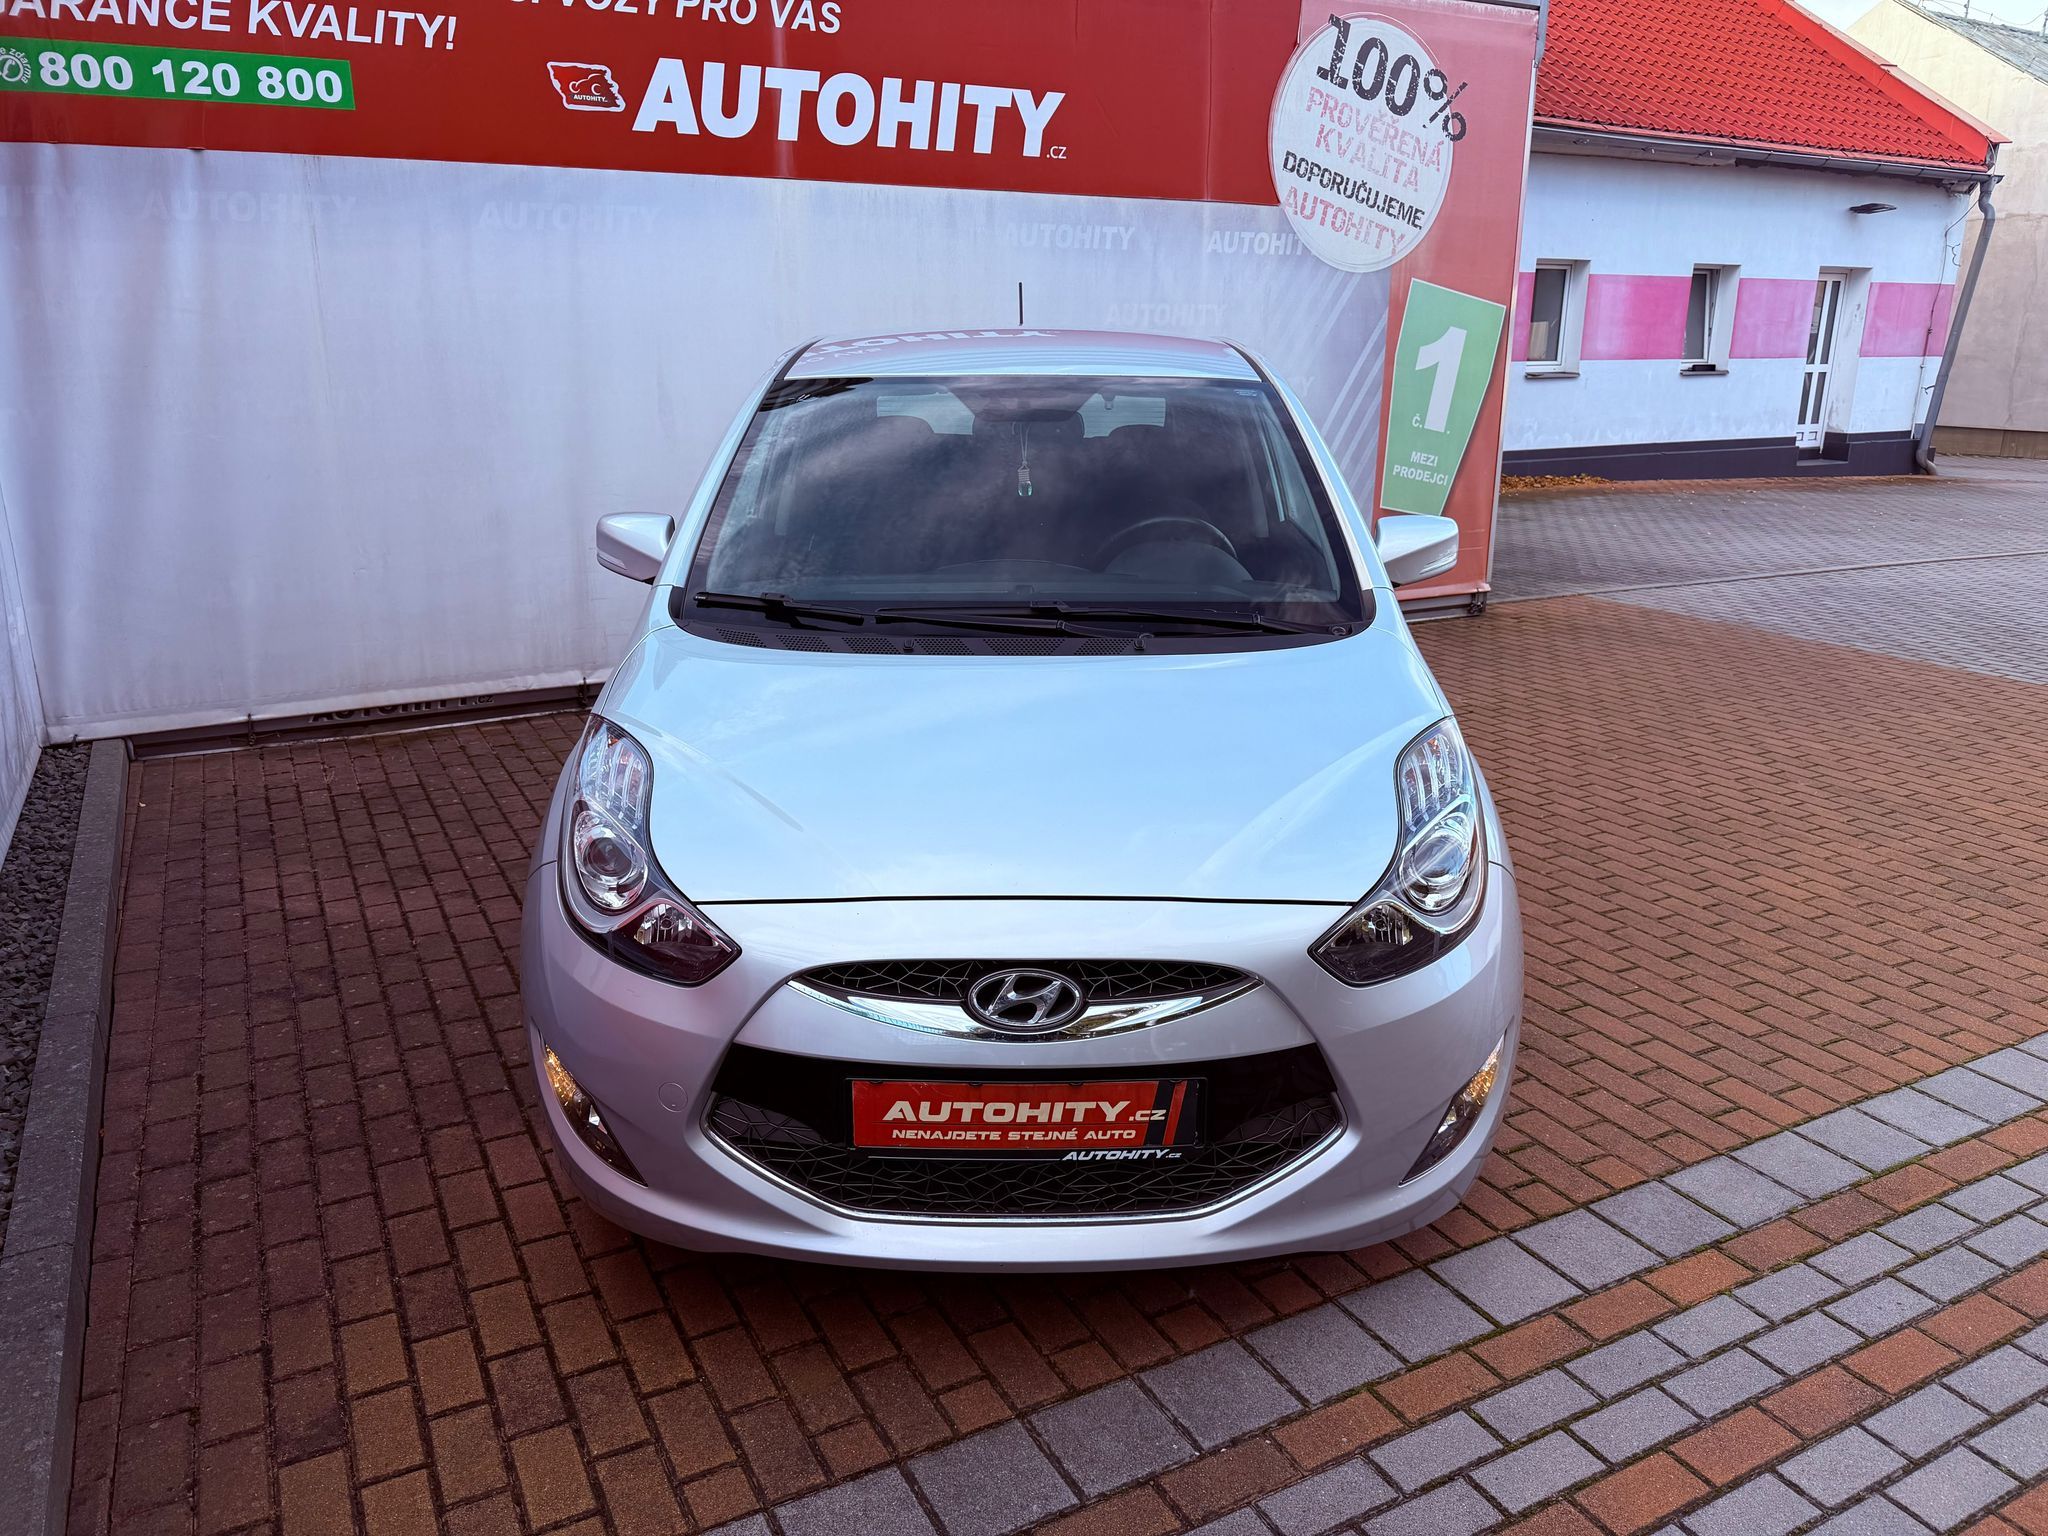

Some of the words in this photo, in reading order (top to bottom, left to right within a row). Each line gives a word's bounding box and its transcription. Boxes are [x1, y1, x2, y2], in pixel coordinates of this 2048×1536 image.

[247, 0, 457, 50] KVALITY!
[9, 48, 32, 84] zdarma
[38, 51, 134, 91] 800
[152, 58, 241, 97] 120
[257, 66, 344, 103] 800
[1317, 13, 1468, 142] 100%
[1305, 86, 1444, 172] PROVĚŘENÁ
[1315, 124, 1418, 192] KVALITA
[143, 190, 356, 222] AUTOHITY
[1282, 150, 1425, 230] DOPORUČUJEME
[479, 201, 663, 232] AUTOHITY
[1284, 186, 1406, 256] AUTOHITY
[1006, 223, 1135, 250] AUTOHITY
[1105, 303, 1228, 329] AUTOHITY
[1392, 464, 1449, 486] PRODEJCI
[1410, 451, 1438, 467] MEZI
[892, 1129, 1001, 1141] NENAJDETE
[1008, 1128, 1078, 1141] STEJNÉ
[1083, 1129, 1136, 1140] AUTO
